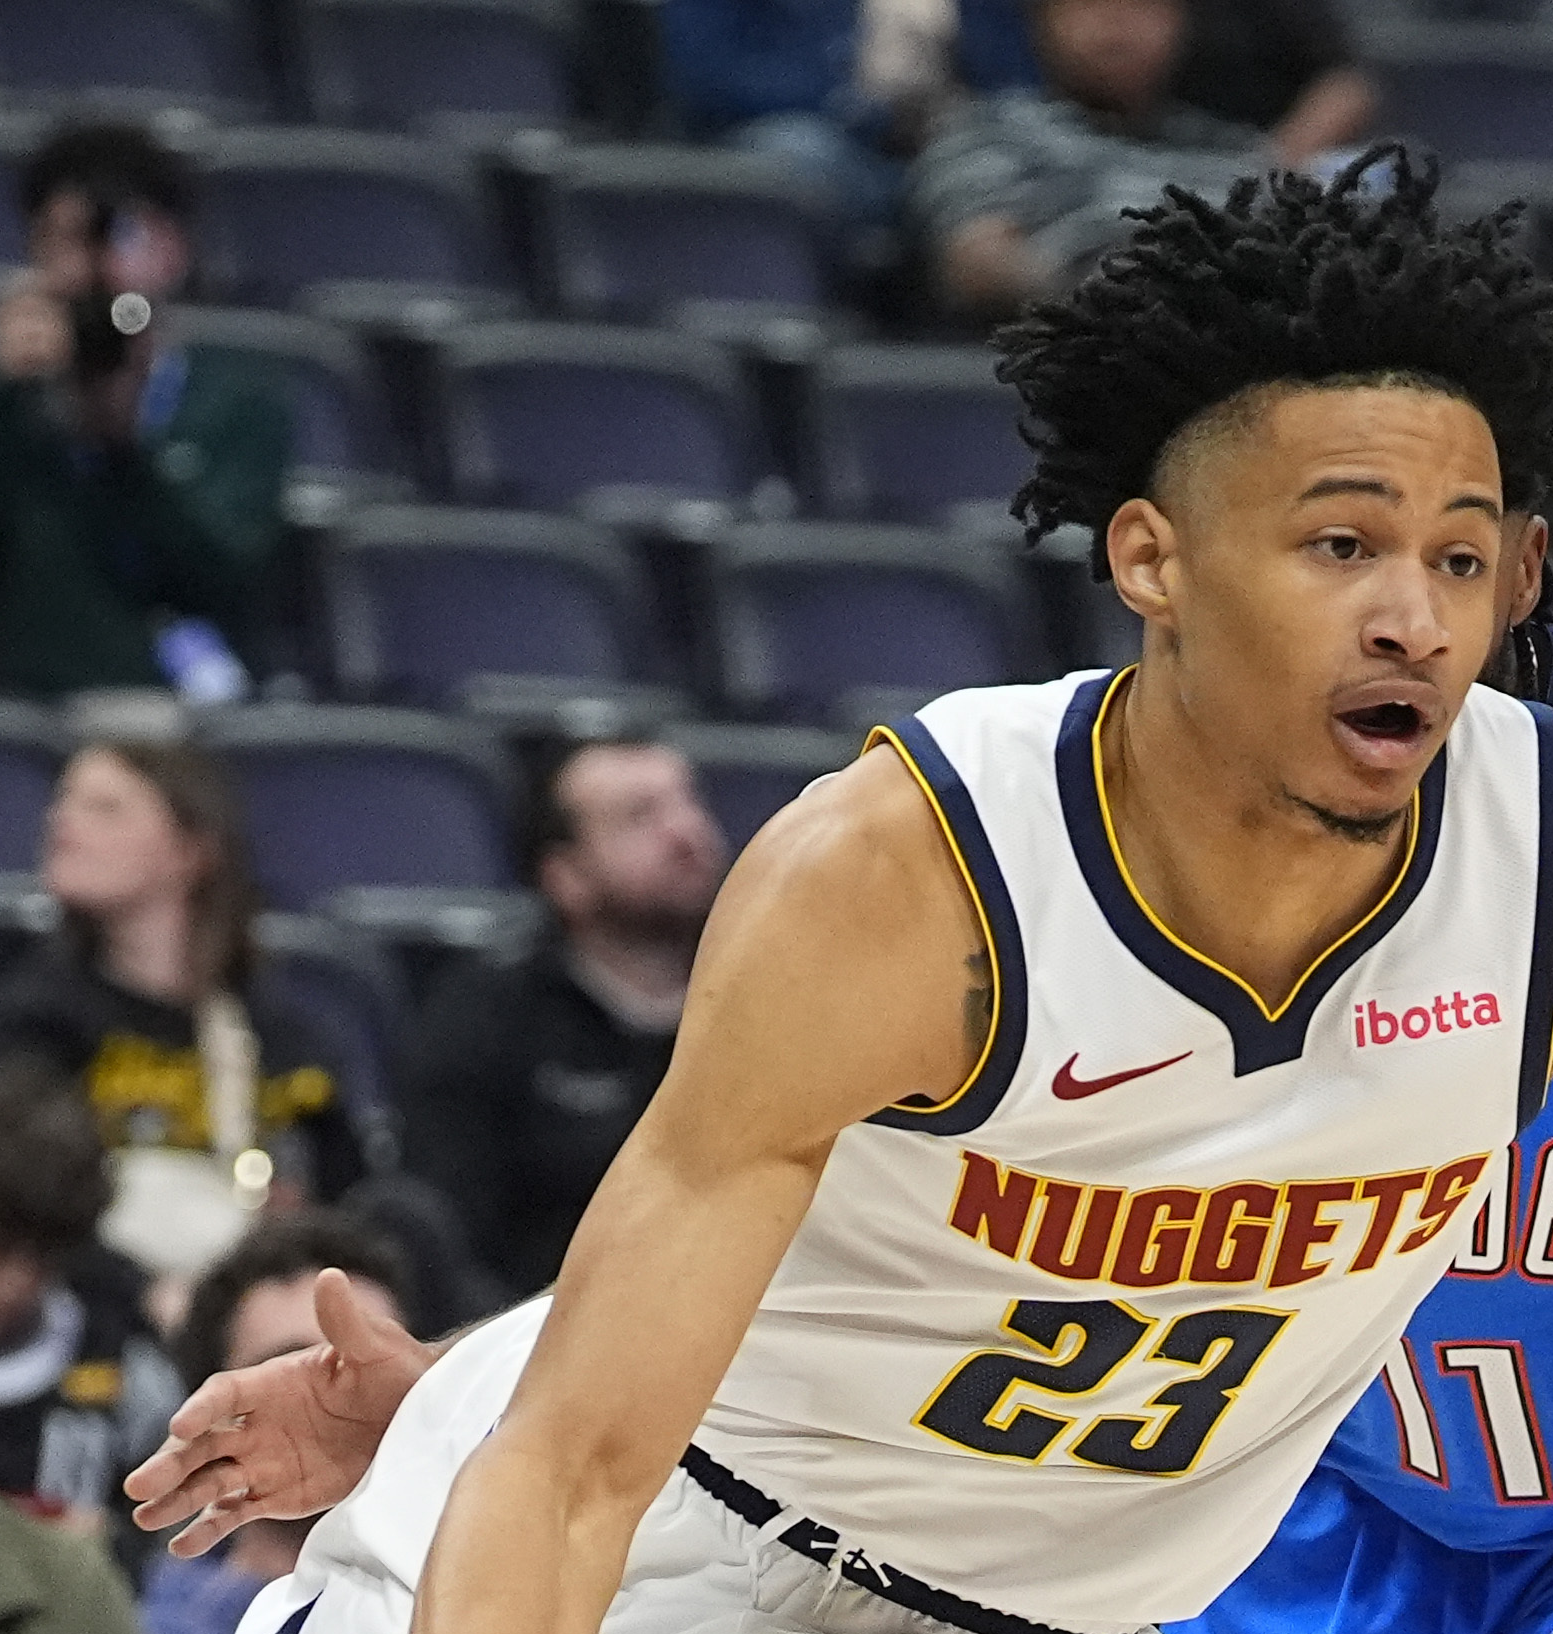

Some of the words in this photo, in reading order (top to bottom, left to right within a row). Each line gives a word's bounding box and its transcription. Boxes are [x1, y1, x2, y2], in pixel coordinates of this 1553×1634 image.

[1354, 991, 1502, 1048] ibotta
[948, 1148, 1494, 1290] NUGGETS
[910, 1296, 1301, 1480] 23
